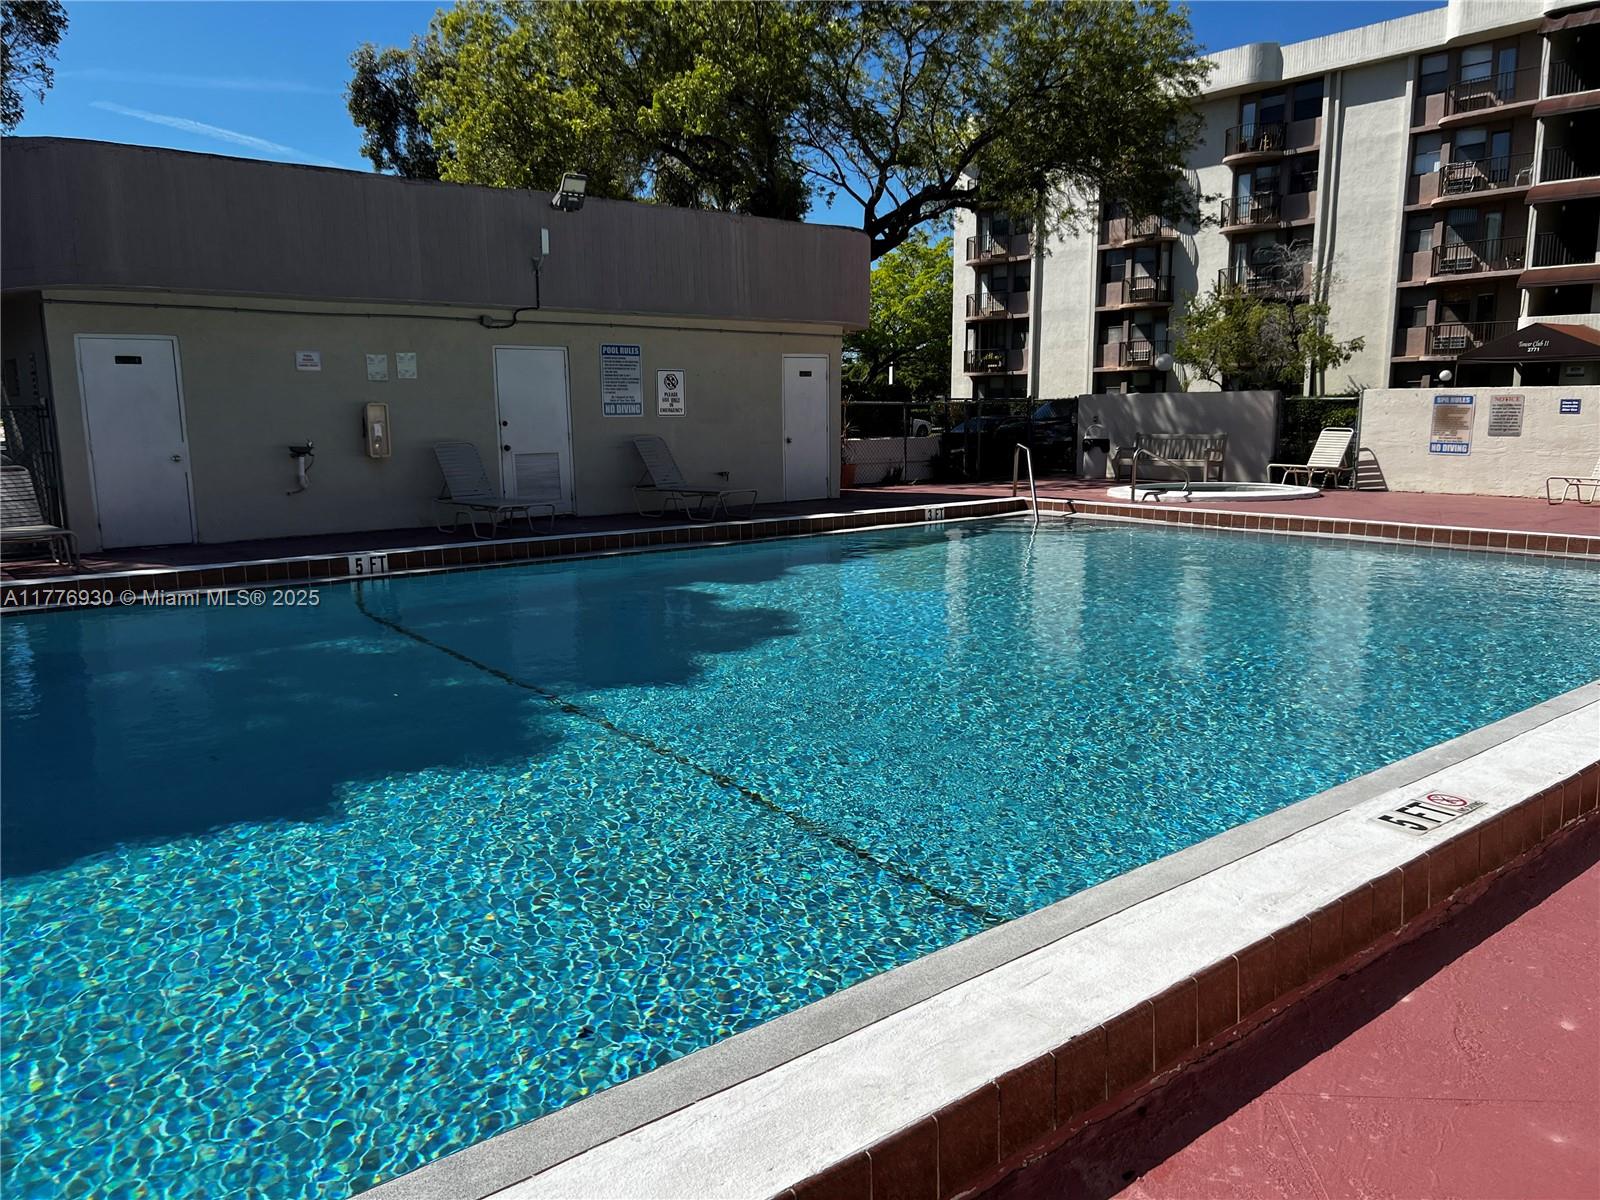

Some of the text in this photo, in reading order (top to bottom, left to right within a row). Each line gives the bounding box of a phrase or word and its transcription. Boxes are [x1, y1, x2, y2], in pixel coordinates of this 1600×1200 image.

[602, 346, 639, 355] POOL RULES
[605, 404, 641, 414] NO DIVING
[1431, 443, 1468, 453] NO DIVING
[355, 555, 386, 575] 5 FT
[1395, 801, 1457, 823] FT
[1378, 814, 1428, 831] 5
